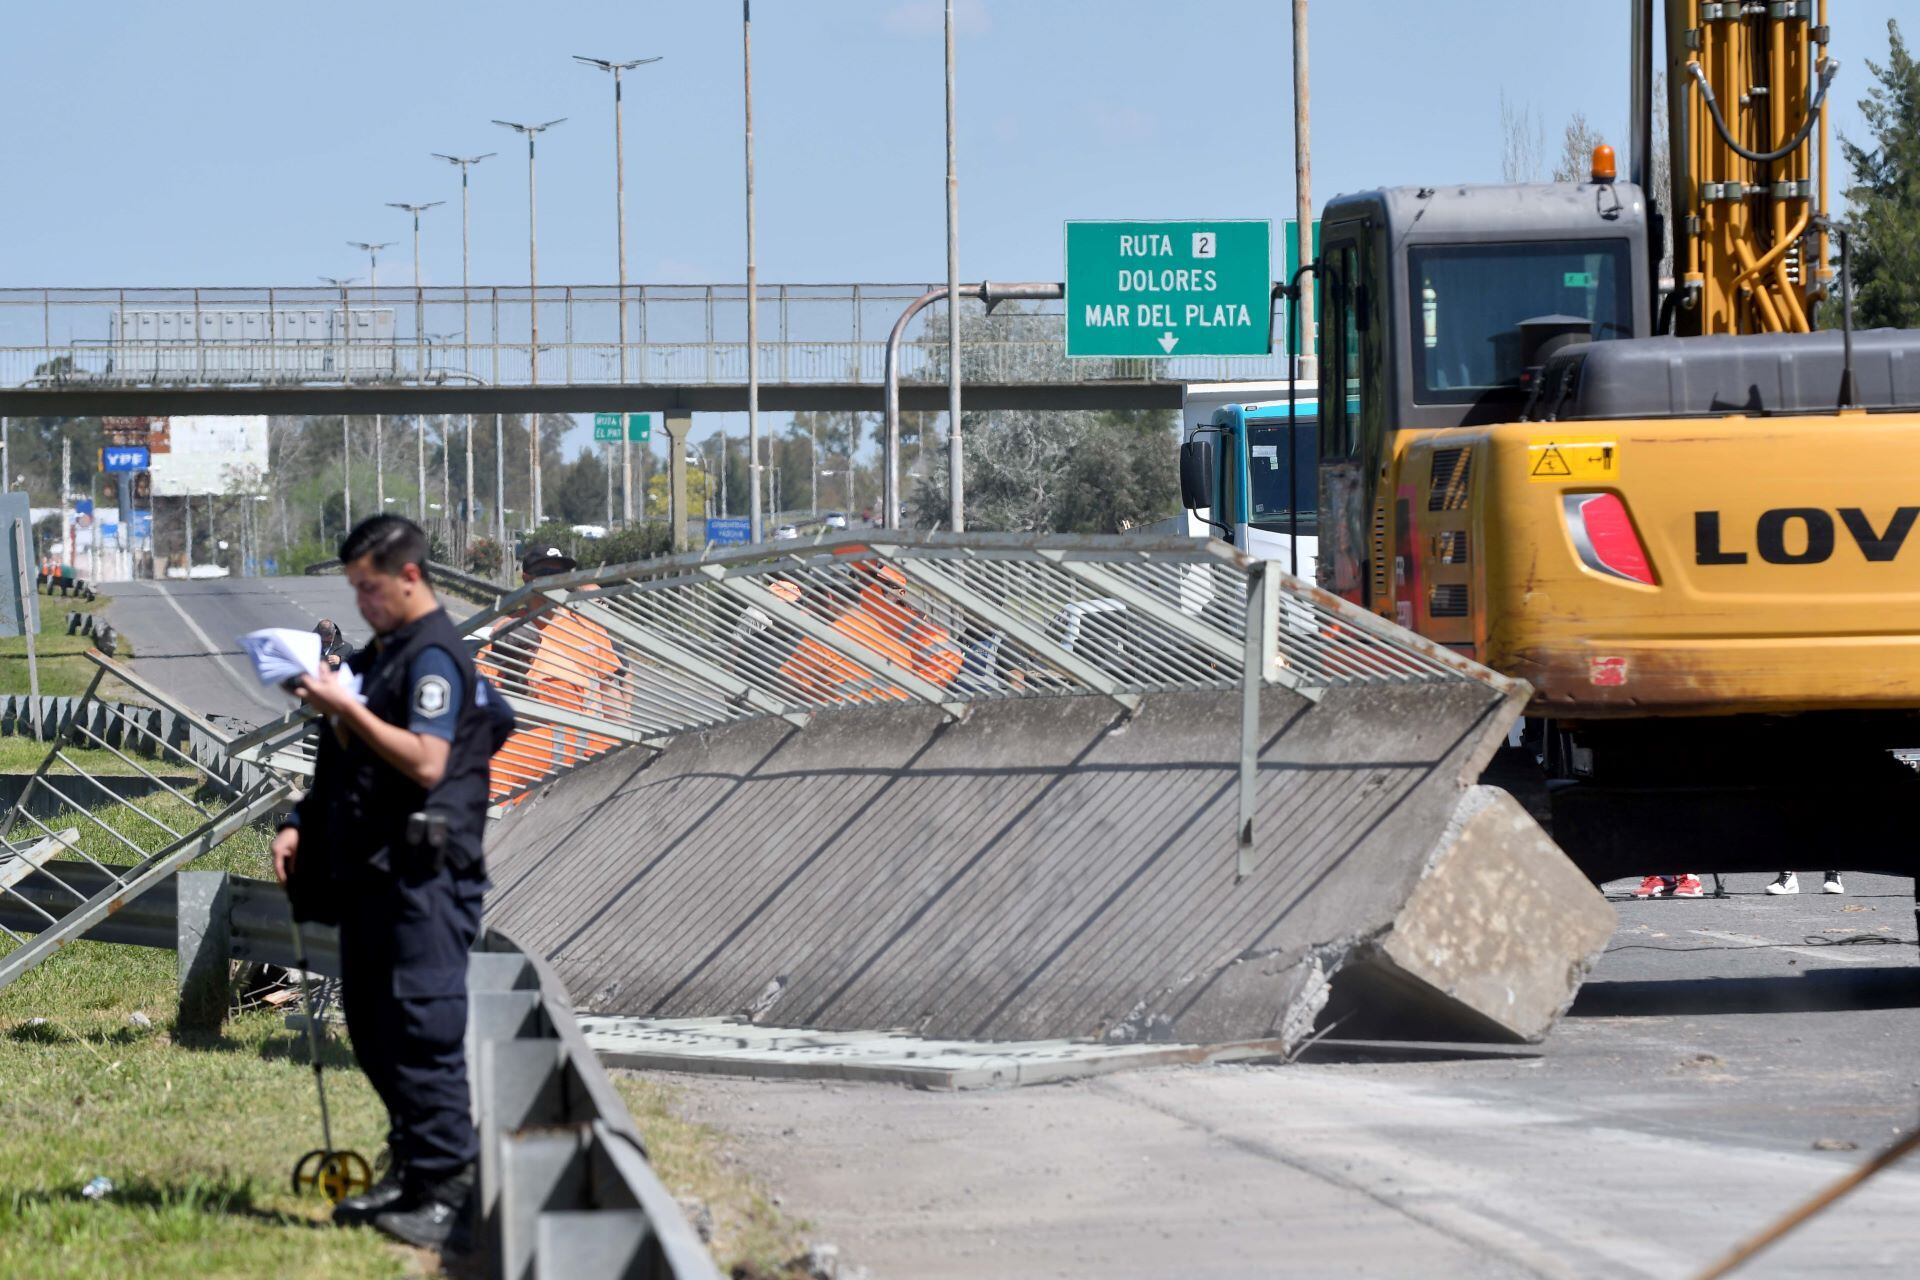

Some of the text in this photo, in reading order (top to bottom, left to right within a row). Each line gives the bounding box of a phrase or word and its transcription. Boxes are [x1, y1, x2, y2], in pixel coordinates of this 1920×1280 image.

[1120, 234, 1209, 257] RUTA 2
[1118, 269, 1217, 292] DOLORES
[1085, 304, 1251, 327] MAR DEL PLATA
[107, 452, 143, 466] YPF
[1694, 507, 1920, 565] LOV
